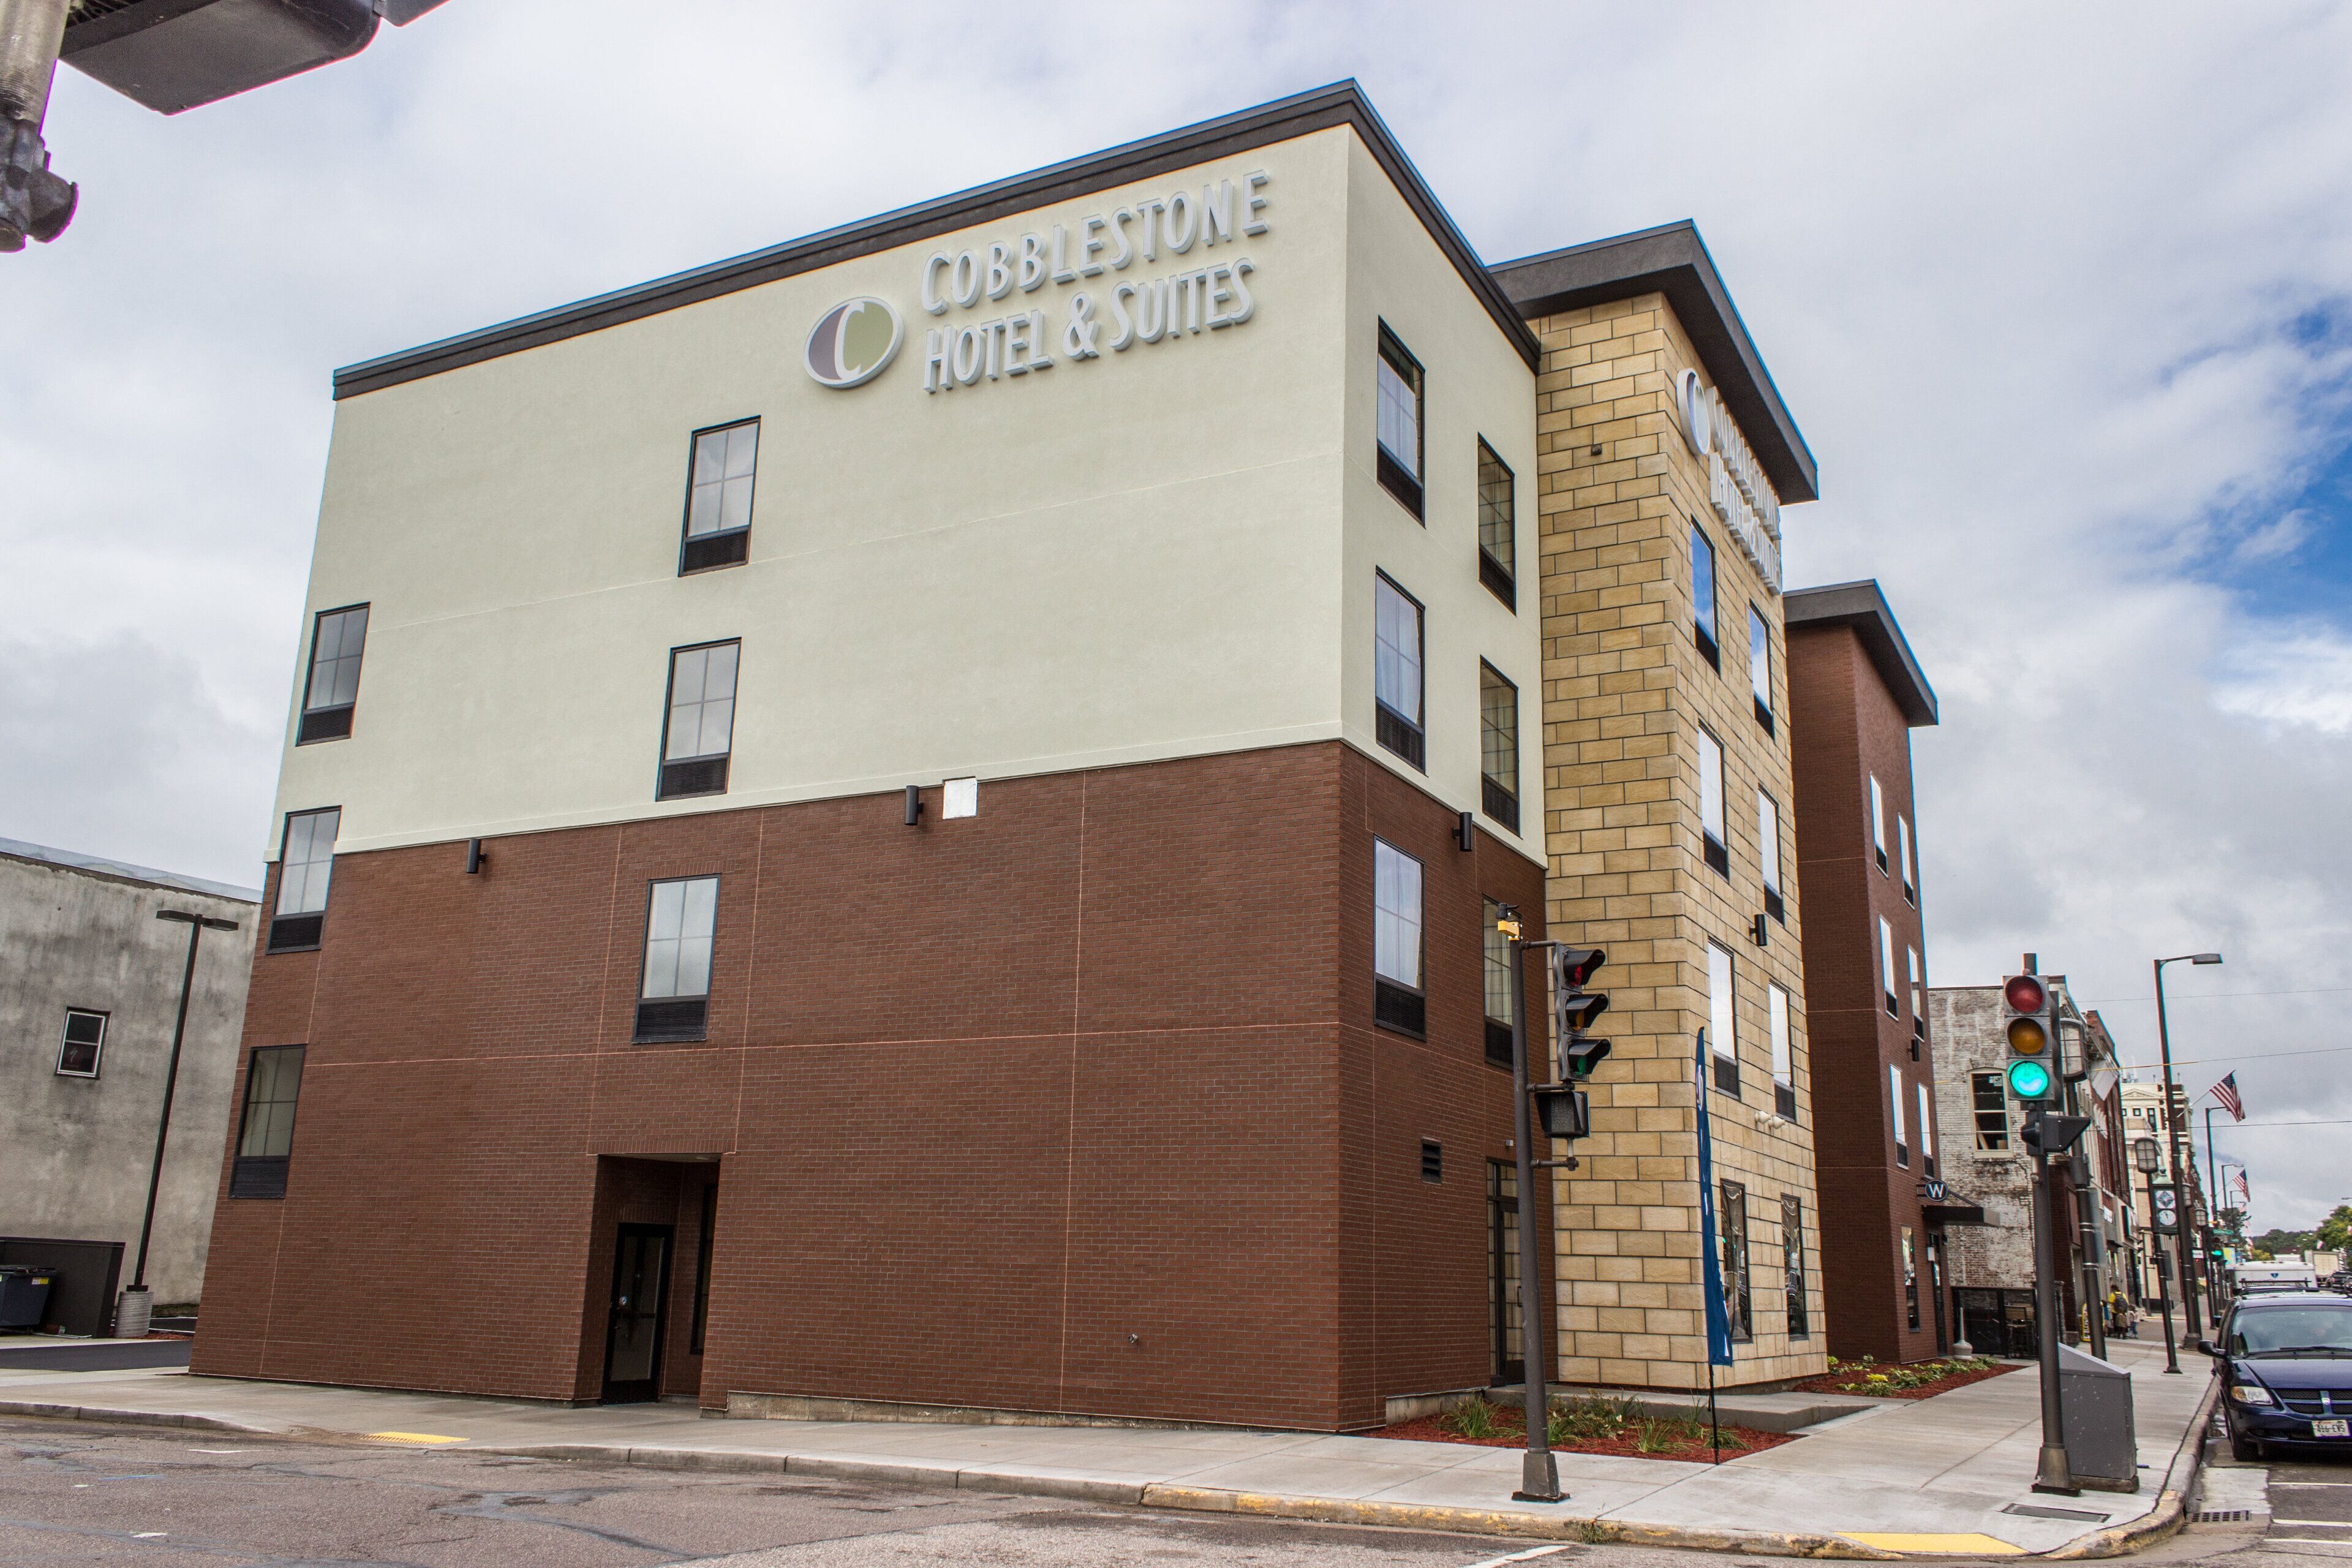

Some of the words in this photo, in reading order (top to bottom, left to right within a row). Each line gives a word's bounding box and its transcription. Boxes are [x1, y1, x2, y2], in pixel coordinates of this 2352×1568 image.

[921, 169, 1268, 316] COBBLESTONE
[923, 309, 1054, 393] HOTEL
[1062, 291, 1100, 361] &
[1108, 257, 1254, 351] SUITES
[1927, 1183, 1944, 1198] W
